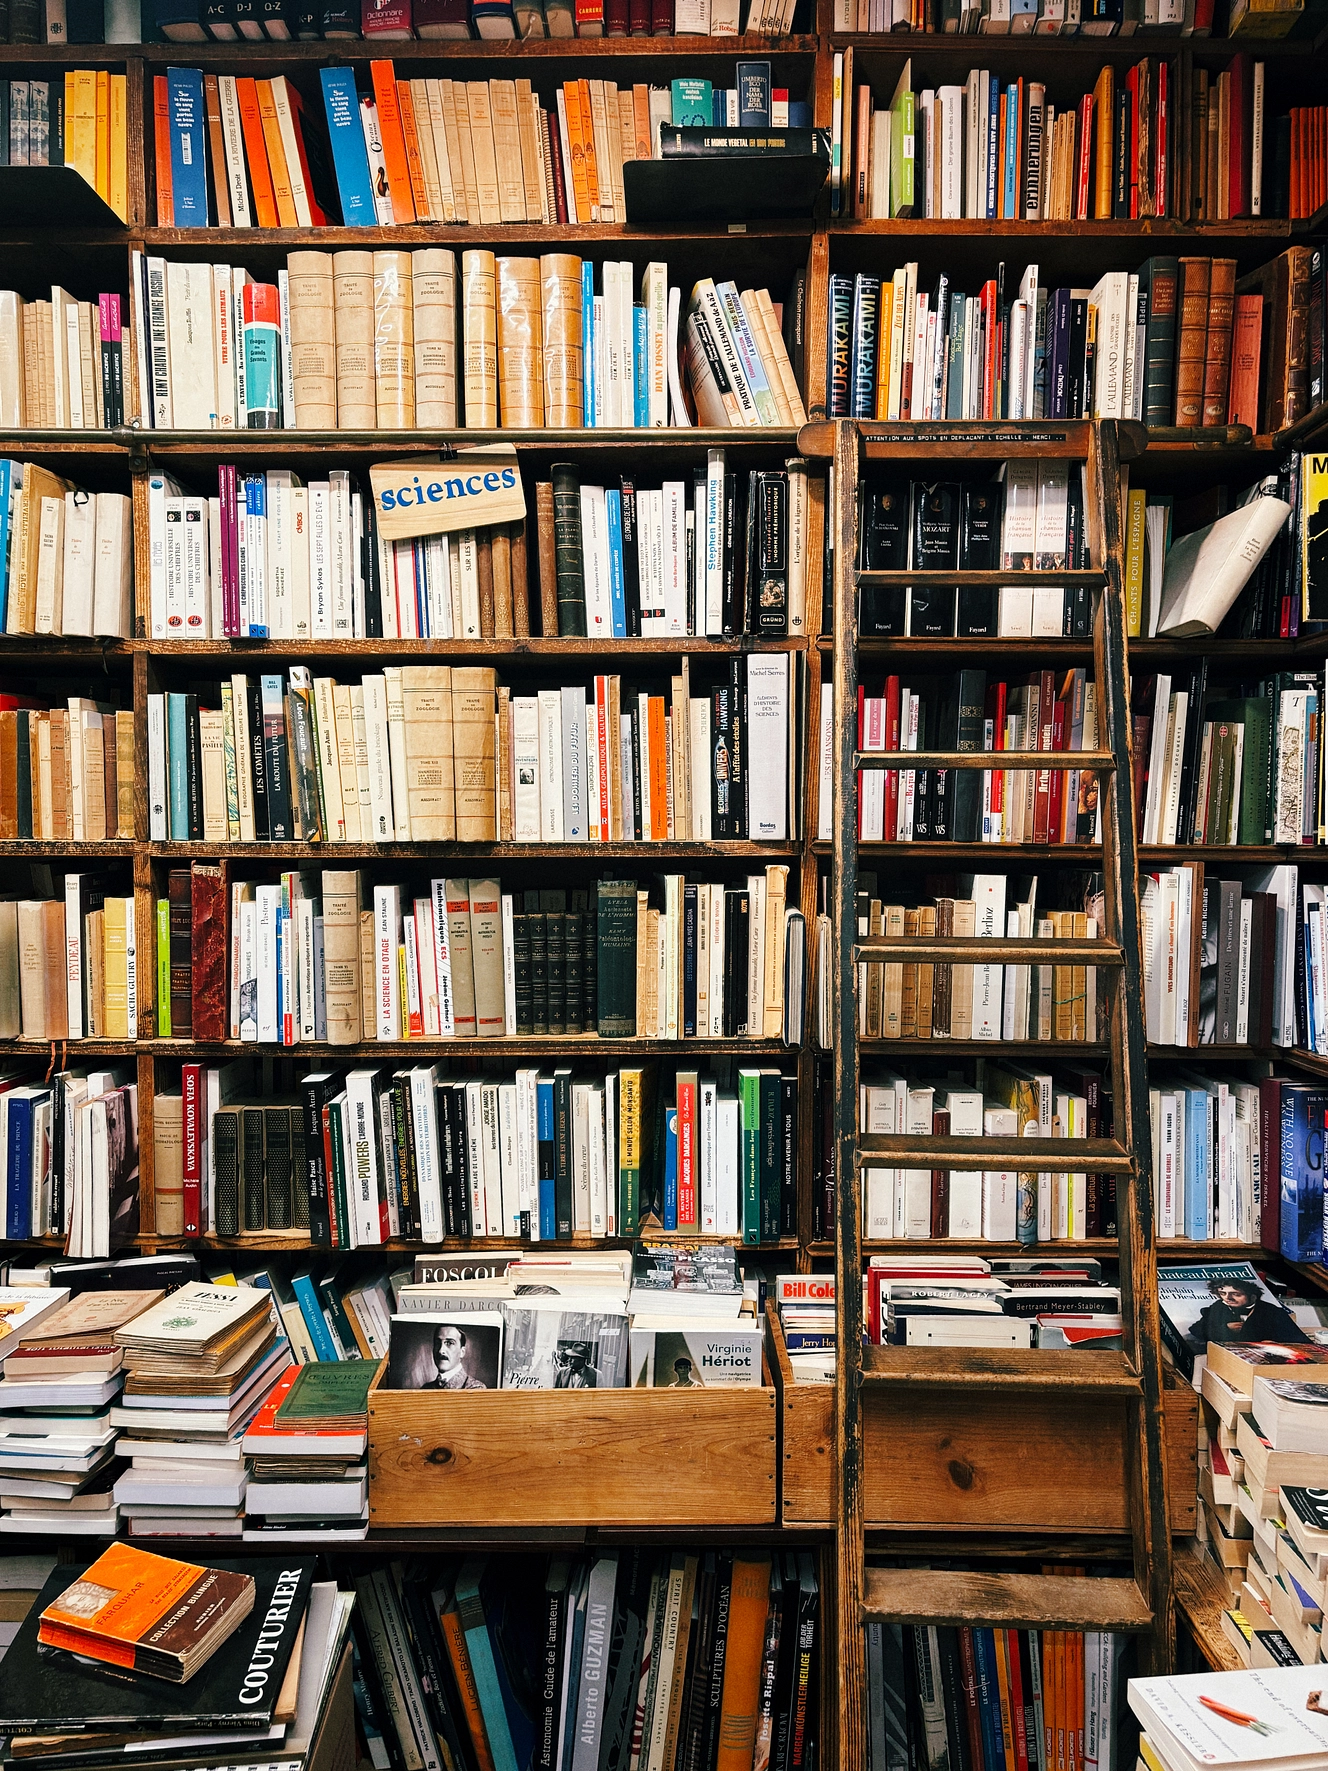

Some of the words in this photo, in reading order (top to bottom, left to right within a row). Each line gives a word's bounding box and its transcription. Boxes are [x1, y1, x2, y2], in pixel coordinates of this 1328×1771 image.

[207, 4, 224, 15] A-C
[224, 79, 234, 105] GUERRE
[227, 106, 235, 116] LA
[228, 116, 236, 127] DE
[232, 156, 240, 166] LA
[1024, 105, 1043, 210] erinnerungen
[235, 173, 243, 190] Droit
[235, 190, 245, 212] Michel
[150, 270, 163, 298] PASSION
[653, 281, 665, 302] gorilles
[706, 291, 715, 299] Z
[152, 299, 165, 328] ETRANGE
[654, 302, 663, 310] des
[656, 310, 665, 322] pays
[713, 308, 722, 316] de
[1138, 300, 1147, 324] PIPER
[152, 328, 165, 342] UNE
[656, 322, 663, 331] au
[716, 317, 737, 361] L'ALLEMAND
[153, 346, 167, 377] CHAUVIN
[653, 331, 663, 367] FOSSEY
[731, 362, 739, 372] DE
[155, 378, 168, 397] REMY
[654, 369, 663, 393] DIAN
[733, 374, 752, 410] PRATIQUE
[1107, 351, 1118, 411] L'ALLEMAND
[1124, 357, 1134, 407] L'ALLEMAND
[381, 468, 515, 511] sciences
[708, 479, 718, 524] Hawking
[1131, 499, 1142, 550] L'ESPAGNE
[708, 527, 718, 570] Stephen
[1130, 555, 1139, 581] POUR
[1129, 586, 1139, 625] CHANTS
[875, 623, 892, 631] Fayard
[969, 626, 986, 634] Fayard
[295, 702, 304, 719] Léon
[598, 703, 606, 735] CULTUREL
[719, 689, 728, 731] HAWKING
[1029, 703, 1038, 742] GIOVANNI
[298, 720, 307, 750] Foucault
[1174, 726, 1182, 766] DOCUMENTS
[253, 735, 264, 776] COMÈTES
[599, 743, 607, 789] GÉOPOLITIQUE
[715, 749, 728, 780] UNIVERS
[255, 778, 265, 794] LES
[824, 766, 832, 780] LES
[904, 771, 915, 797] BEATLES
[1172, 770, 1178, 778] ET
[717, 783, 725, 815] GEORGES
[1170, 781, 1178, 811] TRAVAUX
[260, 896, 269, 925] Pasteur
[380, 897, 388, 918] STAUNE
[436, 883, 446, 944] Mathématiques
[68, 936, 79, 982] FEYDEAU
[381, 938, 390, 963] OTAGE
[127, 960, 136, 991] GUITRY
[381, 964, 390, 974] EN
[382, 976, 390, 1008] SCIENCE
[128, 992, 136, 1020] SACHA
[382, 1009, 391, 1019] LA
[186, 1074, 195, 1101] SOFIA
[308, 1089, 316, 1109] Attali
[482, 1090, 490, 1110] AMADO
[309, 1110, 319, 1135] Jacques
[357, 1101, 367, 1140] L'ARBRE-MONDE
[1285, 1097, 1294, 1128] WITH
[186, 1104, 195, 1171] KOVALEVSKAYA
[1285, 1131, 1294, 1149] NO
[309, 1159, 317, 1178] Pascal
[356, 1140, 370, 1179] POWERS
[683, 1159, 691, 1185] JACQUES
[1285, 1152, 1294, 1177] ONE
[580, 1169, 588, 1191] Scènes
[748, 1159, 756, 1188] Français
[310, 1178, 318, 1197] Blaise
[362, 1179, 370, 1201] RICHARD
[677, 1255, 736, 1263] PICASSO
[783, 1282, 806, 1298] Bill
[910, 1290, 952, 1298] ROBERT
[954, 1291, 989, 1299] LACEY
[1173, 1293, 1218, 1301] Diesbach
[401, 1299, 451, 1310] XAVIER
[1014, 1302, 1047, 1311] Bertrand
[1049, 1302, 1104, 1312] Meyer-Stabley
[706, 1344, 752, 1356] Virginie
[800, 1337, 819, 1348] Jerry
[701, 1355, 752, 1368] Hériot
[509, 1373, 540, 1386] Pierre
[96, 1581, 145, 1626] FARQUHAR
[671, 1577, 682, 1606] SPIRIT
[149, 1605, 191, 1643] COLLECTION
[187, 1572, 219, 1606] BILINGUE
[717, 1584, 730, 1633] D'OCÉAN
[238, 1567, 303, 1705] COUTURIER
[546, 1598, 558, 1648] l'amateur
[667, 1610, 678, 1652] COUNTRY
[806, 1619, 815, 1648] TORHEIT
[452, 1627, 468, 1671] BÉNIÈRE
[584, 1602, 607, 1681] GUZMAN
[545, 1650, 556, 1665] de
[544, 1666, 555, 1699] Guide
[710, 1638, 725, 1707] SCULPTURES
[763, 1659, 776, 1698] Rispal
[464, 1673, 478, 1711] LUCIEN
[580, 1687, 599, 1745] Alberto
[759, 1699, 771, 1741] Josette
[1089, 1710, 1097, 1726] Hang
[540, 1705, 553, 1767] Astronomie
[1089, 1726, 1095, 1737] am
[1029, 1741, 1038, 1763] MAISONS
